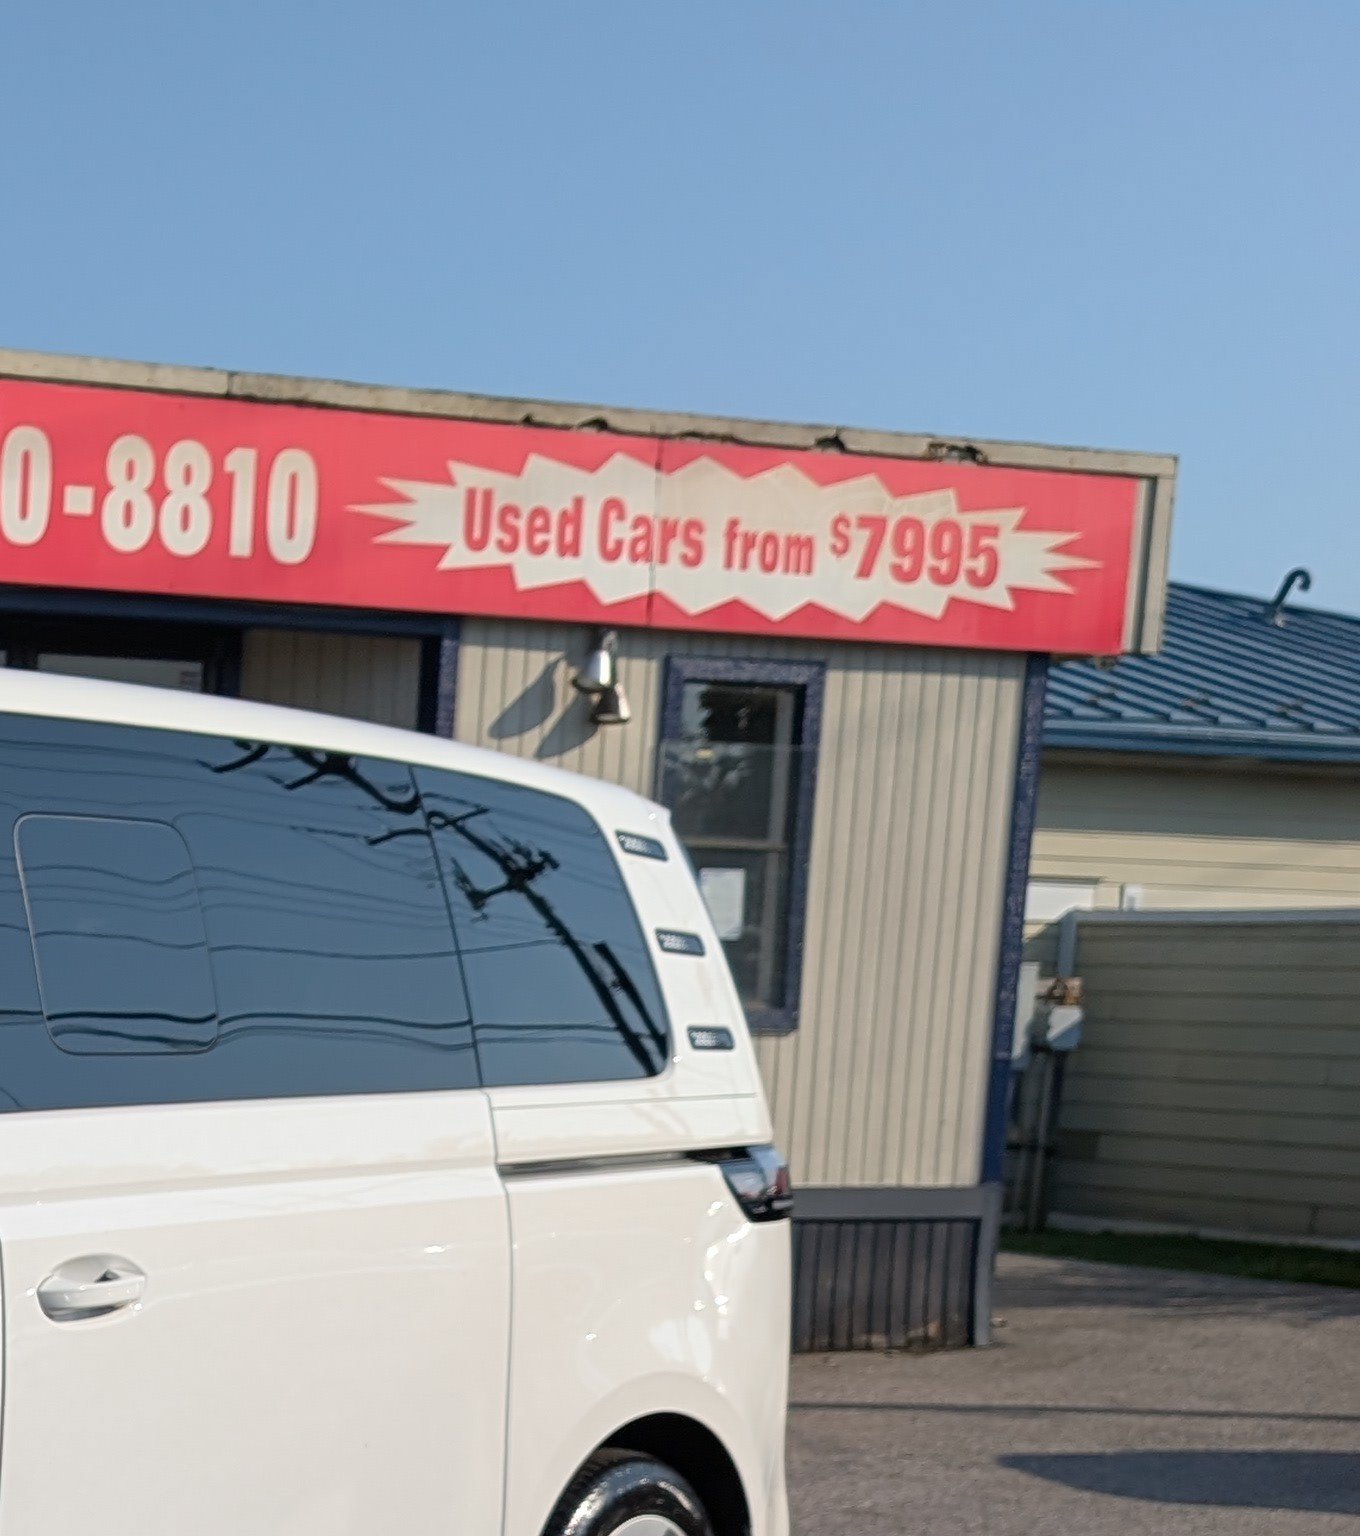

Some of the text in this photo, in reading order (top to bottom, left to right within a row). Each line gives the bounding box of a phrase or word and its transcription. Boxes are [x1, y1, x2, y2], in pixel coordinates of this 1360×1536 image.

[462, 485, 1001, 590] Used Cars from $7995
